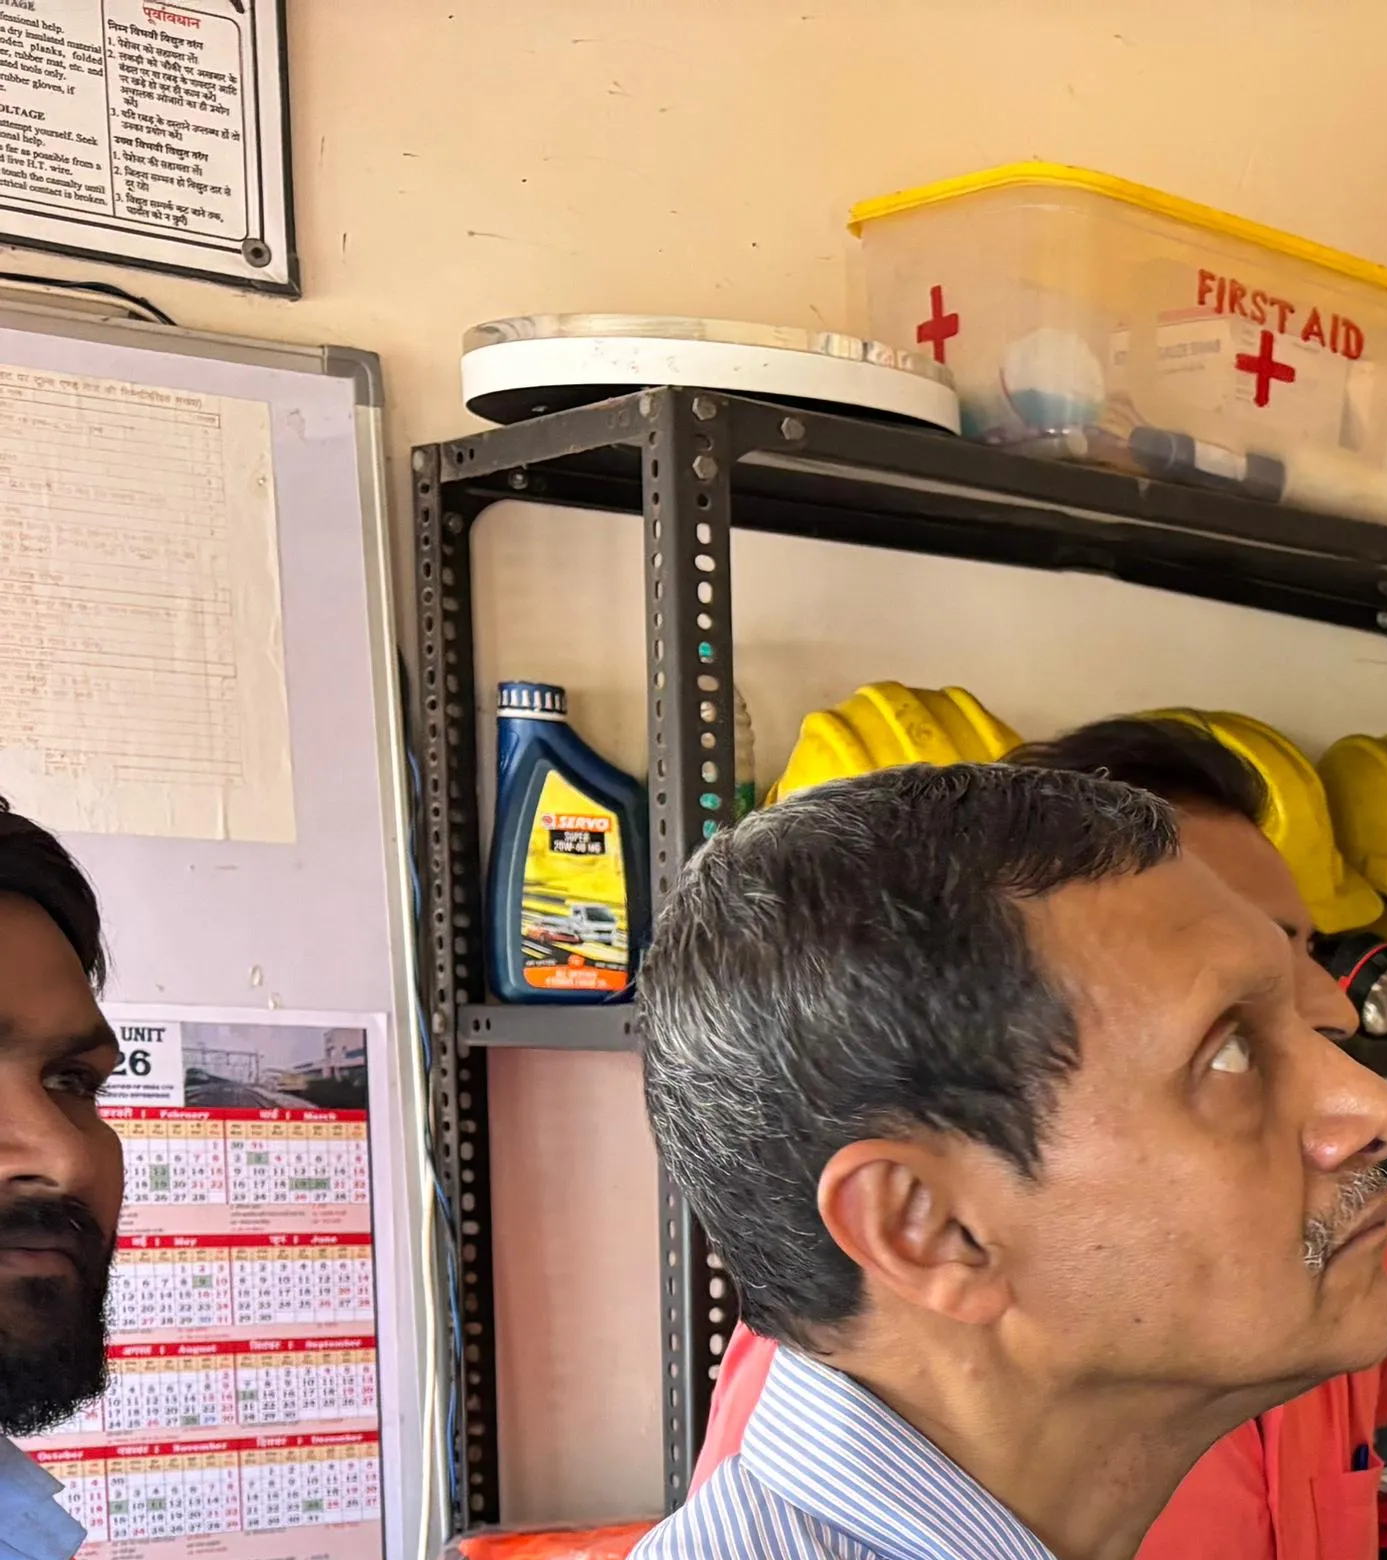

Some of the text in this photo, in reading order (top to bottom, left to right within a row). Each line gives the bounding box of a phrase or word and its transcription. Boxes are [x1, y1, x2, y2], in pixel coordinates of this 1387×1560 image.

[72, 51, 103, 66] folded
[1197, 268, 1365, 361] FIRST AID
[559, 815, 609, 832] SERVO
[120, 1026, 167, 1044] UNIT
[159, 1109, 210, 1121] February
